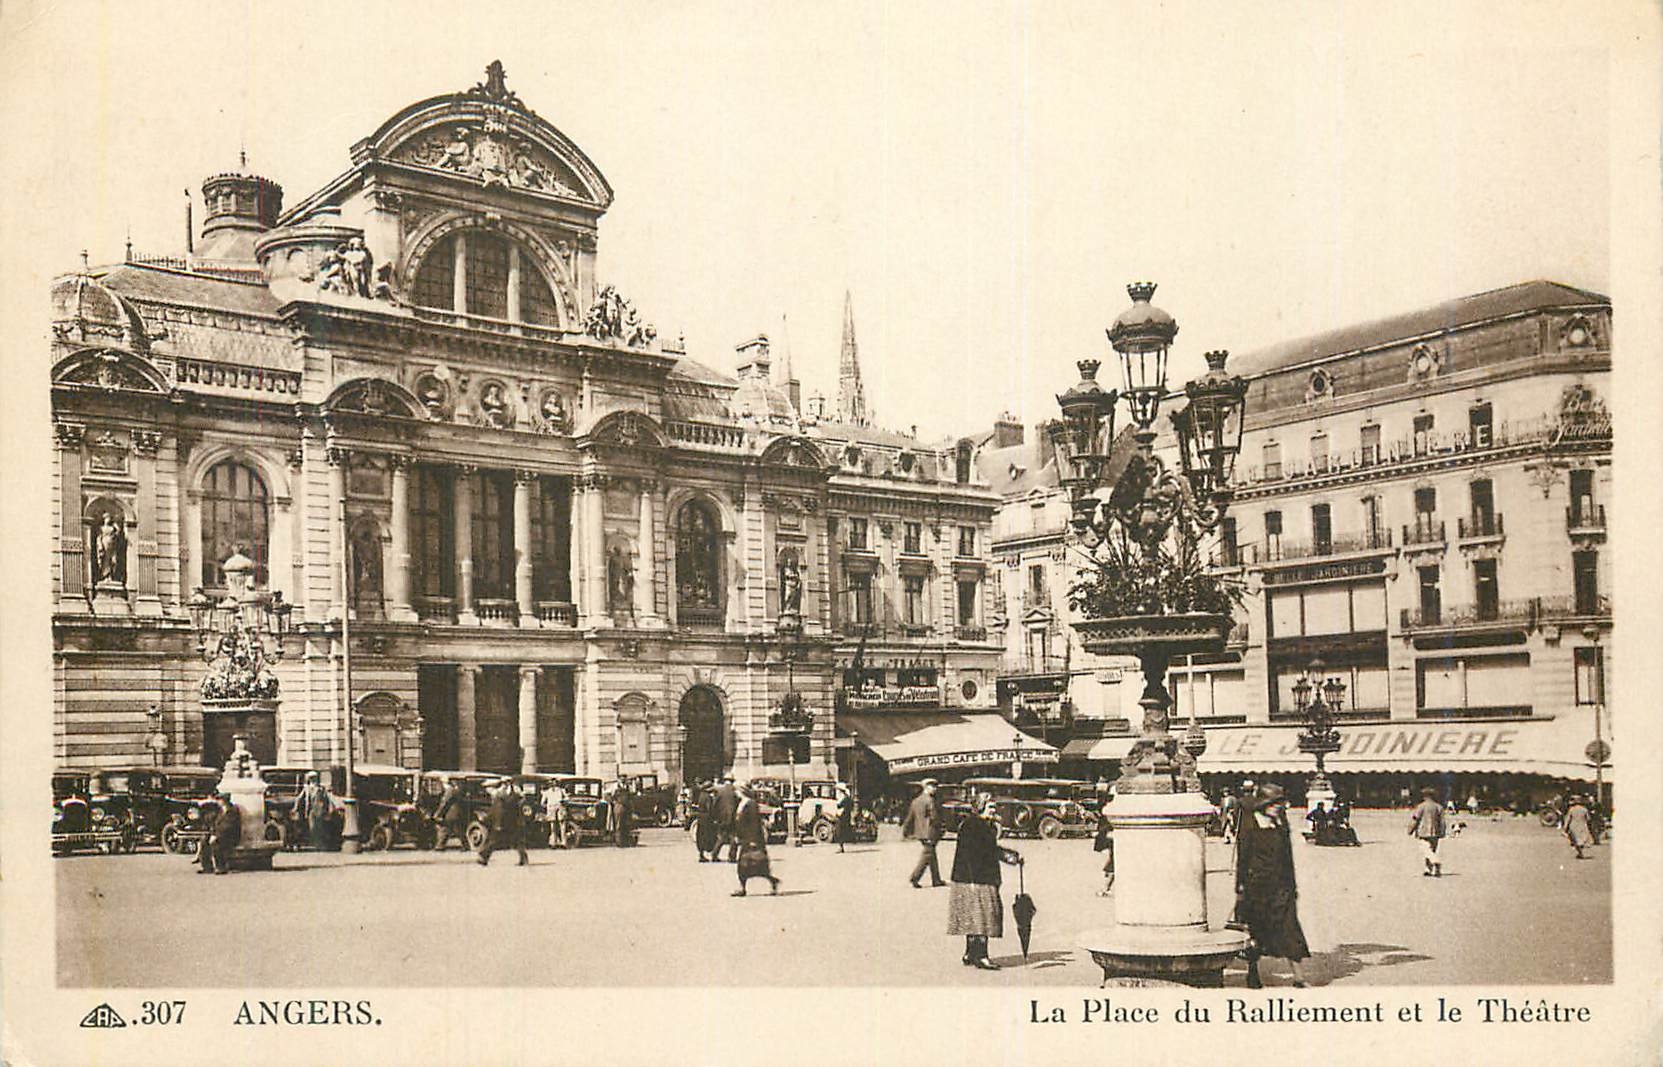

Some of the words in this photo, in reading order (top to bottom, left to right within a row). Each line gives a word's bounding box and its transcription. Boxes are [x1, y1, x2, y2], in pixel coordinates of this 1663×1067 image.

[1279, 730, 1518, 756] JDINIERE
[917, 754, 950, 767] GRAND
[981, 752, 993, 761] DE
